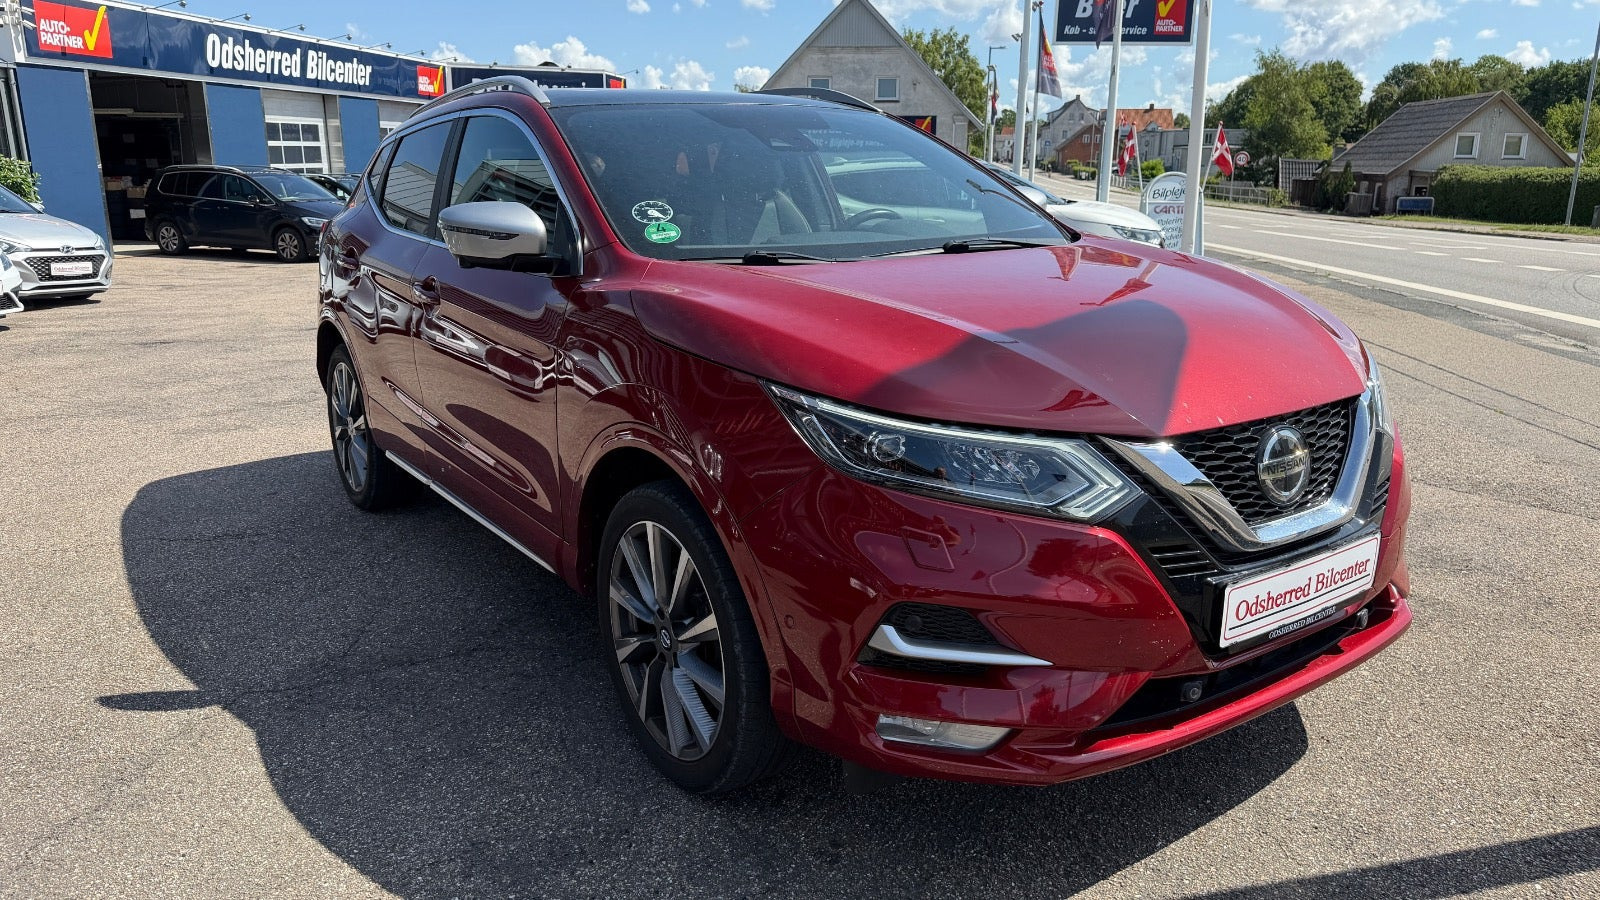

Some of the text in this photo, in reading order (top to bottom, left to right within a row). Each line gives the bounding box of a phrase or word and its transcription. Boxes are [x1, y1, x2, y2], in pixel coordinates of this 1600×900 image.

[40, 18, 70, 34] AUTO-
[1063, 24, 1080, 35] Køb
[1120, 25, 1148, 35] ervice
[1155, 25, 1183, 33] PARTNER
[40, 31, 84, 49] PARTNER
[206, 33, 372, 86] Odsherred Bilcenter
[1266, 456, 1306, 475] NISSAN
[1235, 558, 1371, 621] Odsherred Bilcenter
[1268, 605, 1337, 640] ODSHERRED BILCENTER
